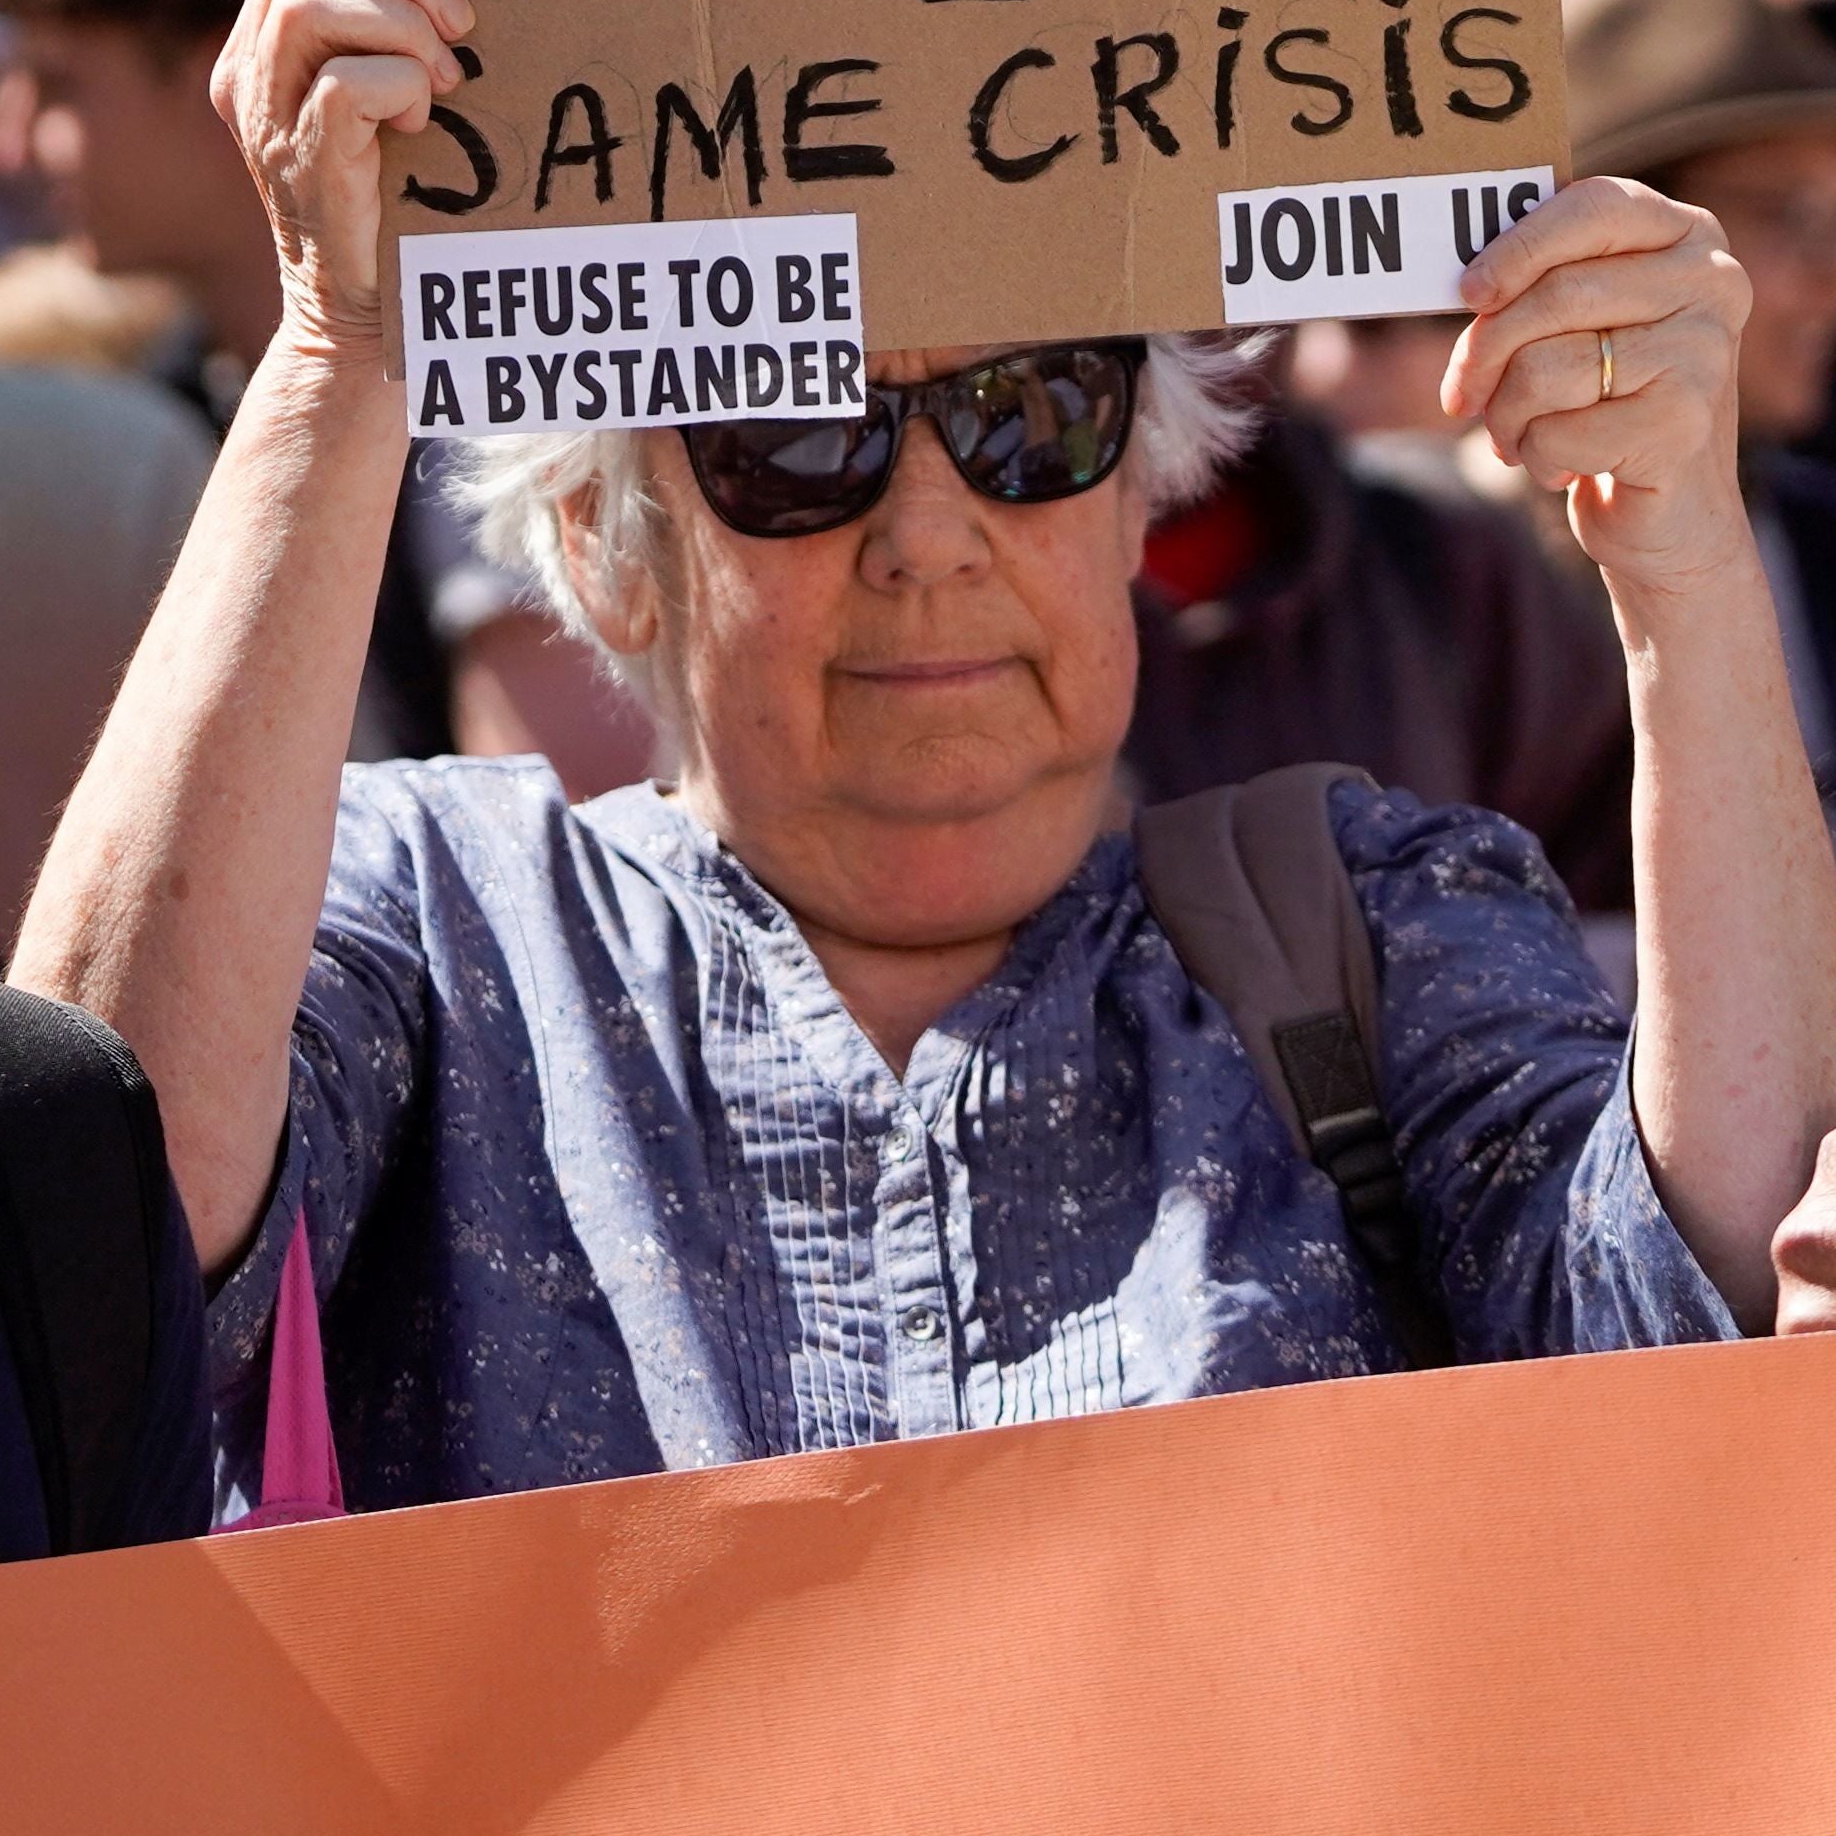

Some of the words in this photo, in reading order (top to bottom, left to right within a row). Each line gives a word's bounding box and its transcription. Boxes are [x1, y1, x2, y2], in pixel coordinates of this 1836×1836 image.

[399, 45, 896, 222] SAME
[1226, 193, 1402, 285] JOIN
[421, 263, 648, 341] REFUSE
[669, 257, 754, 328] TO
[776, 253, 851, 323] BE
[420, 359, 465, 426] A
[486, 338, 865, 423] BYSTANDER
